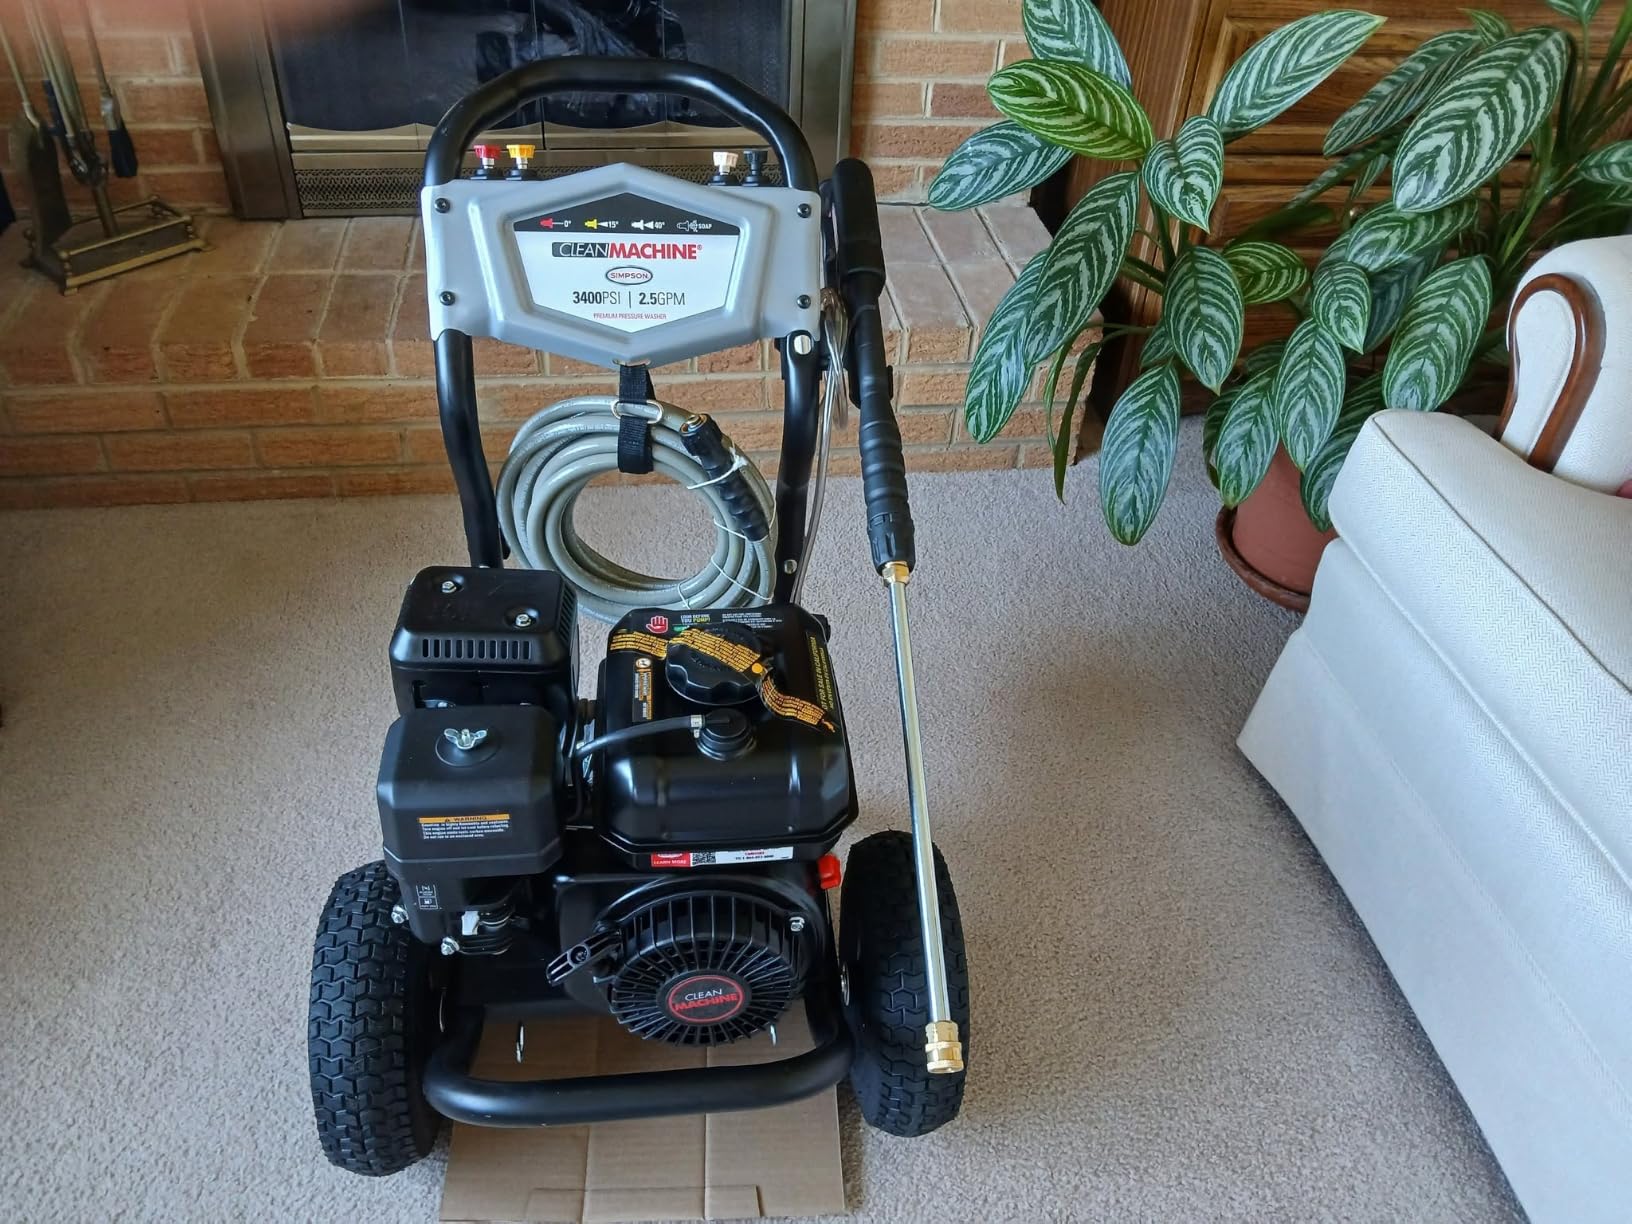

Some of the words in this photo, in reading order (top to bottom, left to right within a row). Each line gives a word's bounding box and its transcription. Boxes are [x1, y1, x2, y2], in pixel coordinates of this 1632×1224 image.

[572, 291, 621, 305] 3400PSI
[639, 291, 686, 305] 2.5GPM
[619, 312, 643, 320] PRESSURE
[684, 988, 723, 1001] CLEAN
[674, 993, 738, 1012] MACHINE
